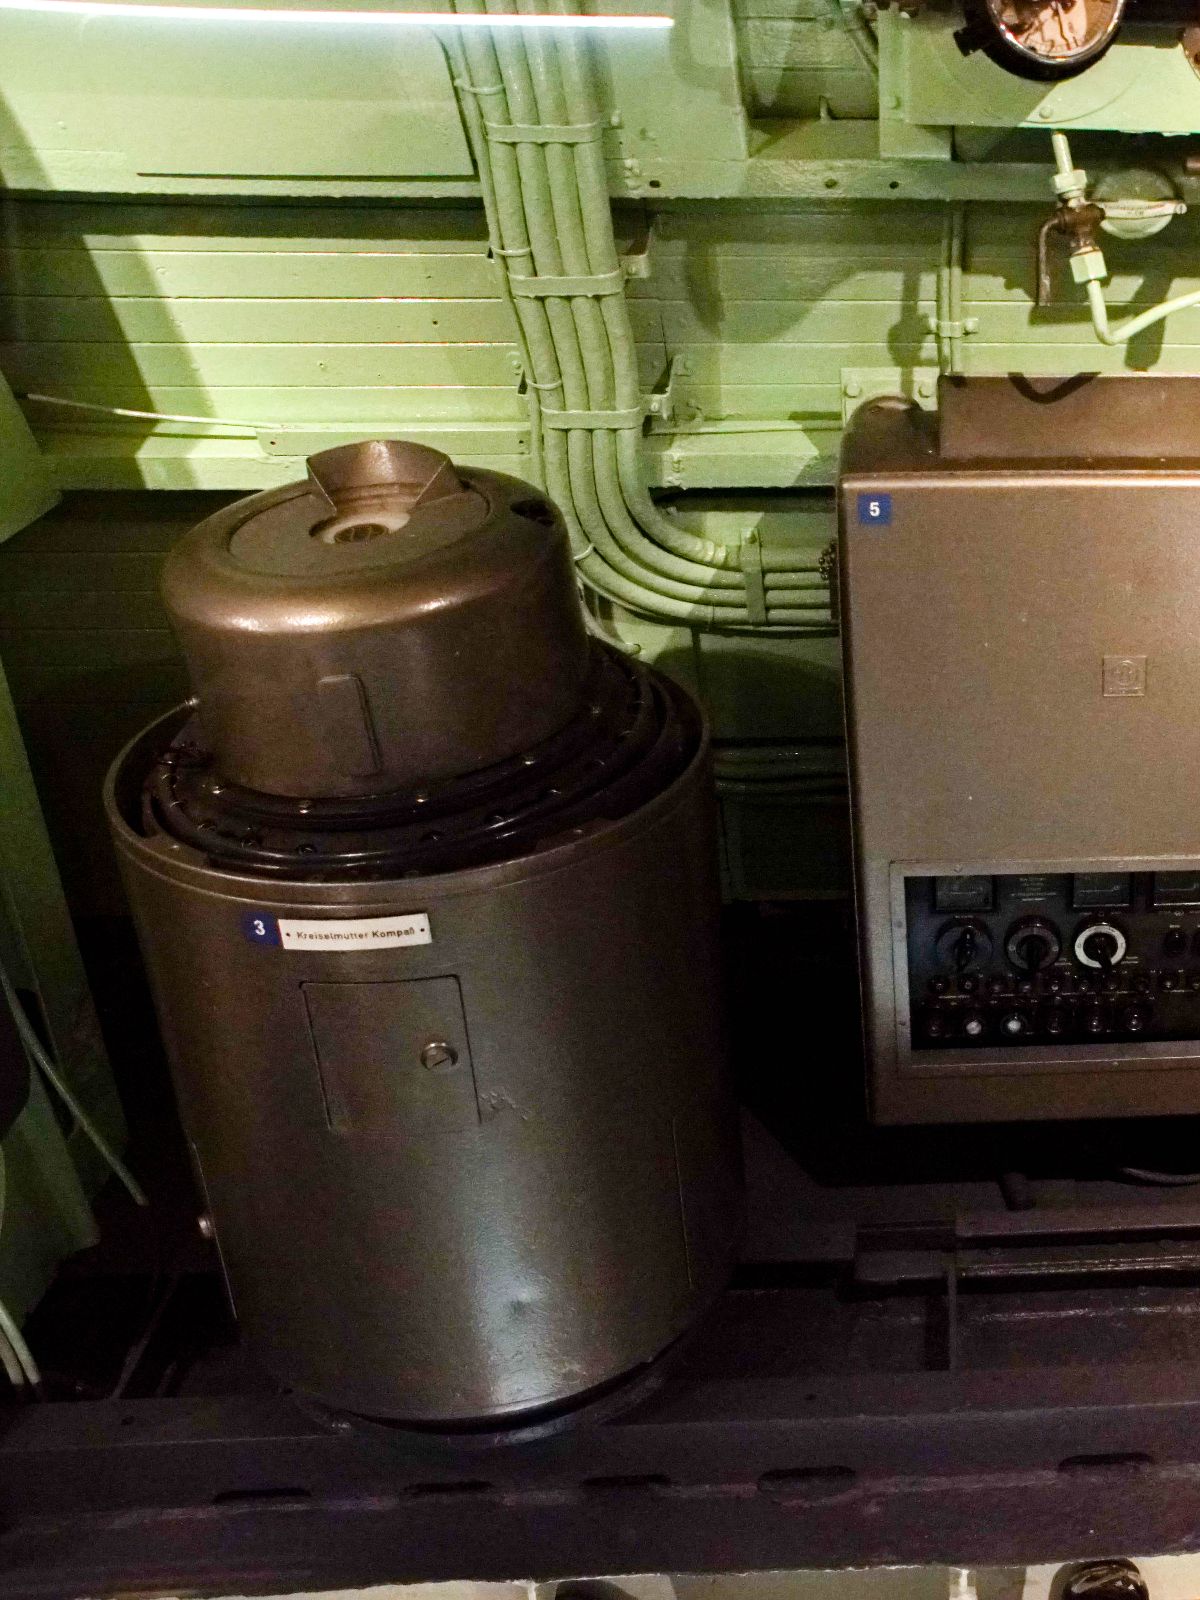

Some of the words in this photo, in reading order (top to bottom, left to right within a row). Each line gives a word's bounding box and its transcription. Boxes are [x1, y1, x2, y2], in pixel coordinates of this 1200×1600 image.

[869, 501, 880, 517] 5
[253, 919, 266, 936] 3
[296, 931, 369, 941] Kreiselmutter
[371, 926, 415, 939] Kompaß
